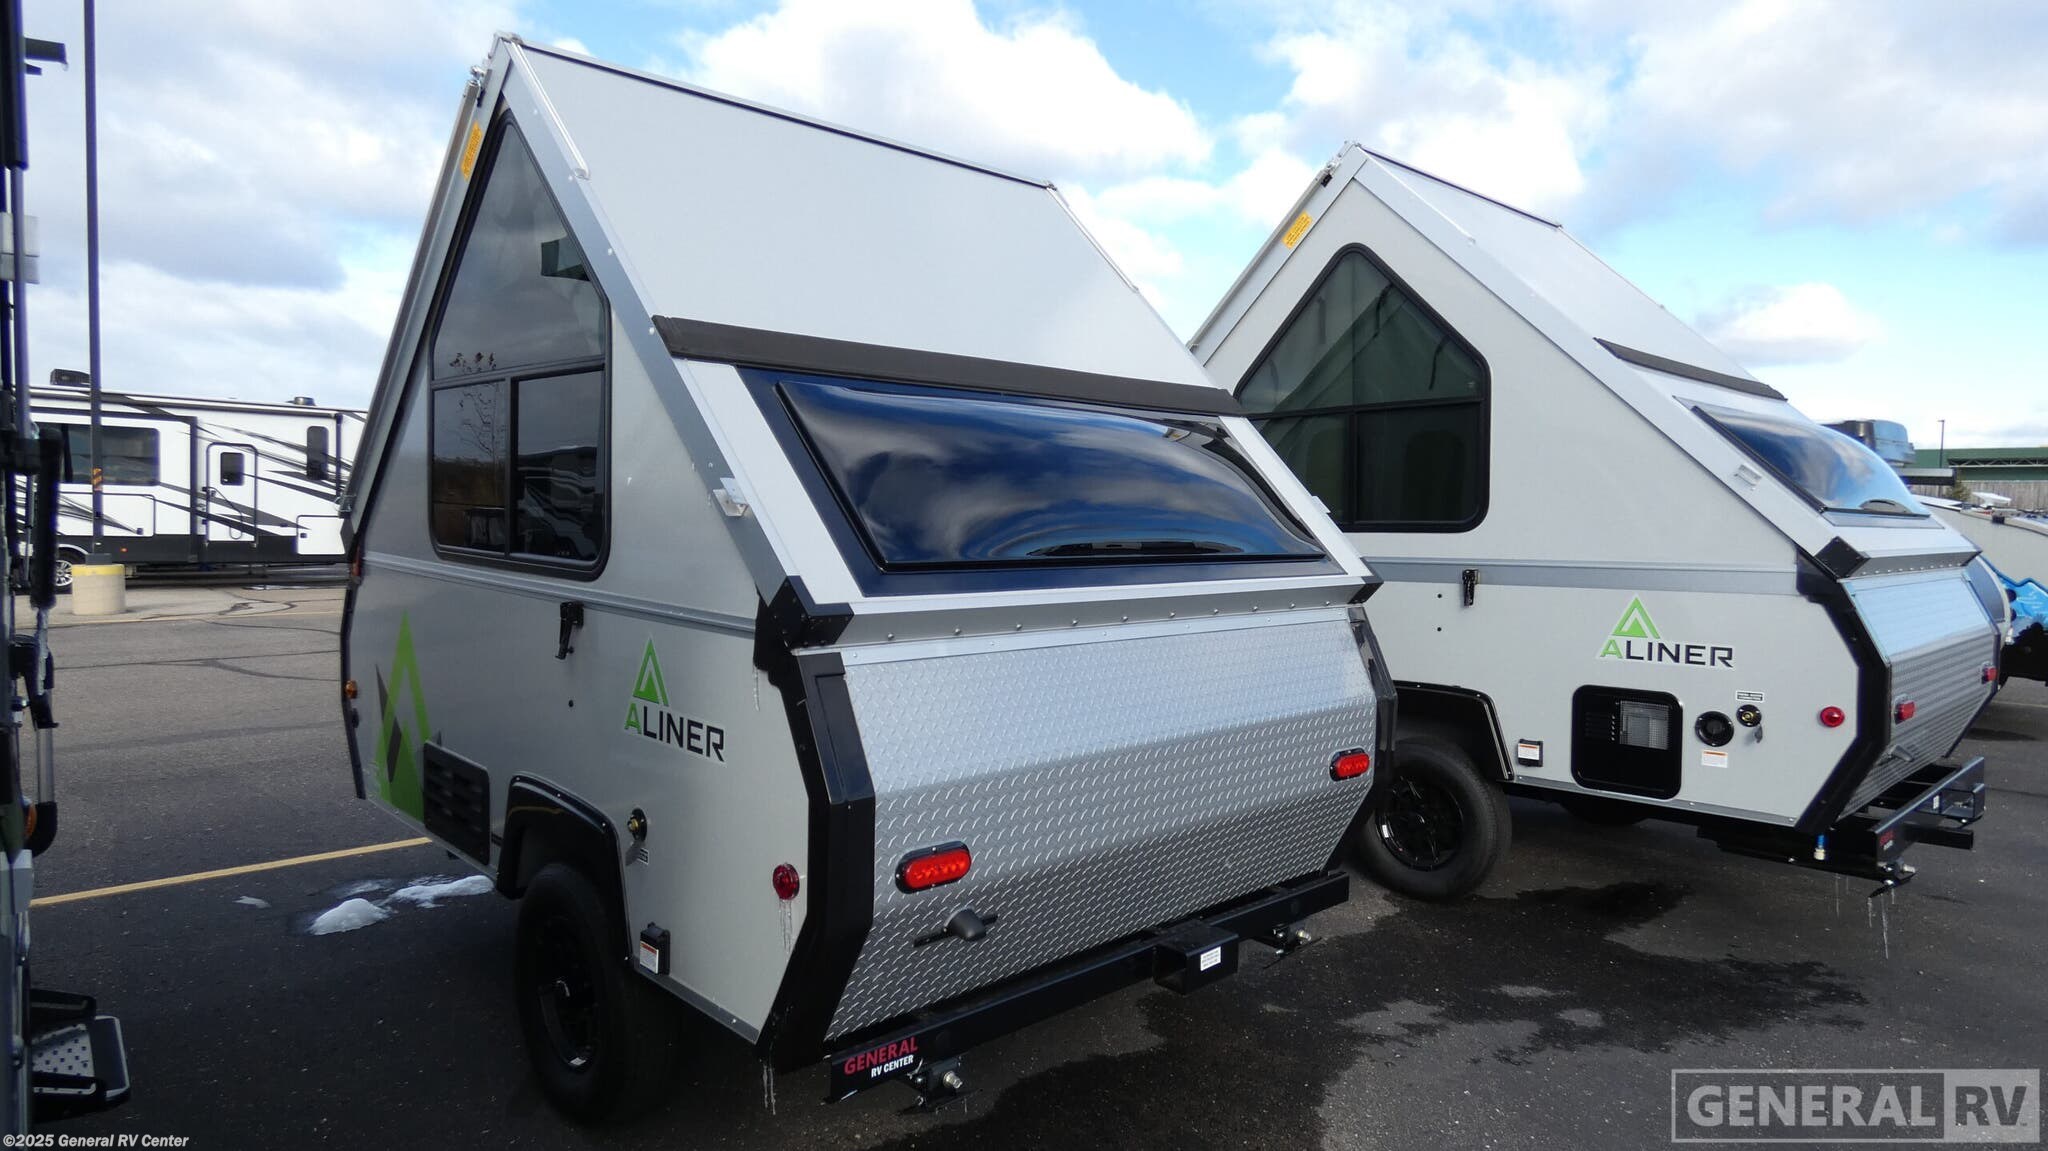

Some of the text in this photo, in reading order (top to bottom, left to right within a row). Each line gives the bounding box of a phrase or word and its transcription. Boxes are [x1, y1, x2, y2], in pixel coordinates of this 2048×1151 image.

[1600, 639, 1733, 668] ALINER
[624, 702, 725, 762] ALINER
[844, 1036, 918, 1075] GENERAL
[871, 1054, 914, 1078] RV CENTER
